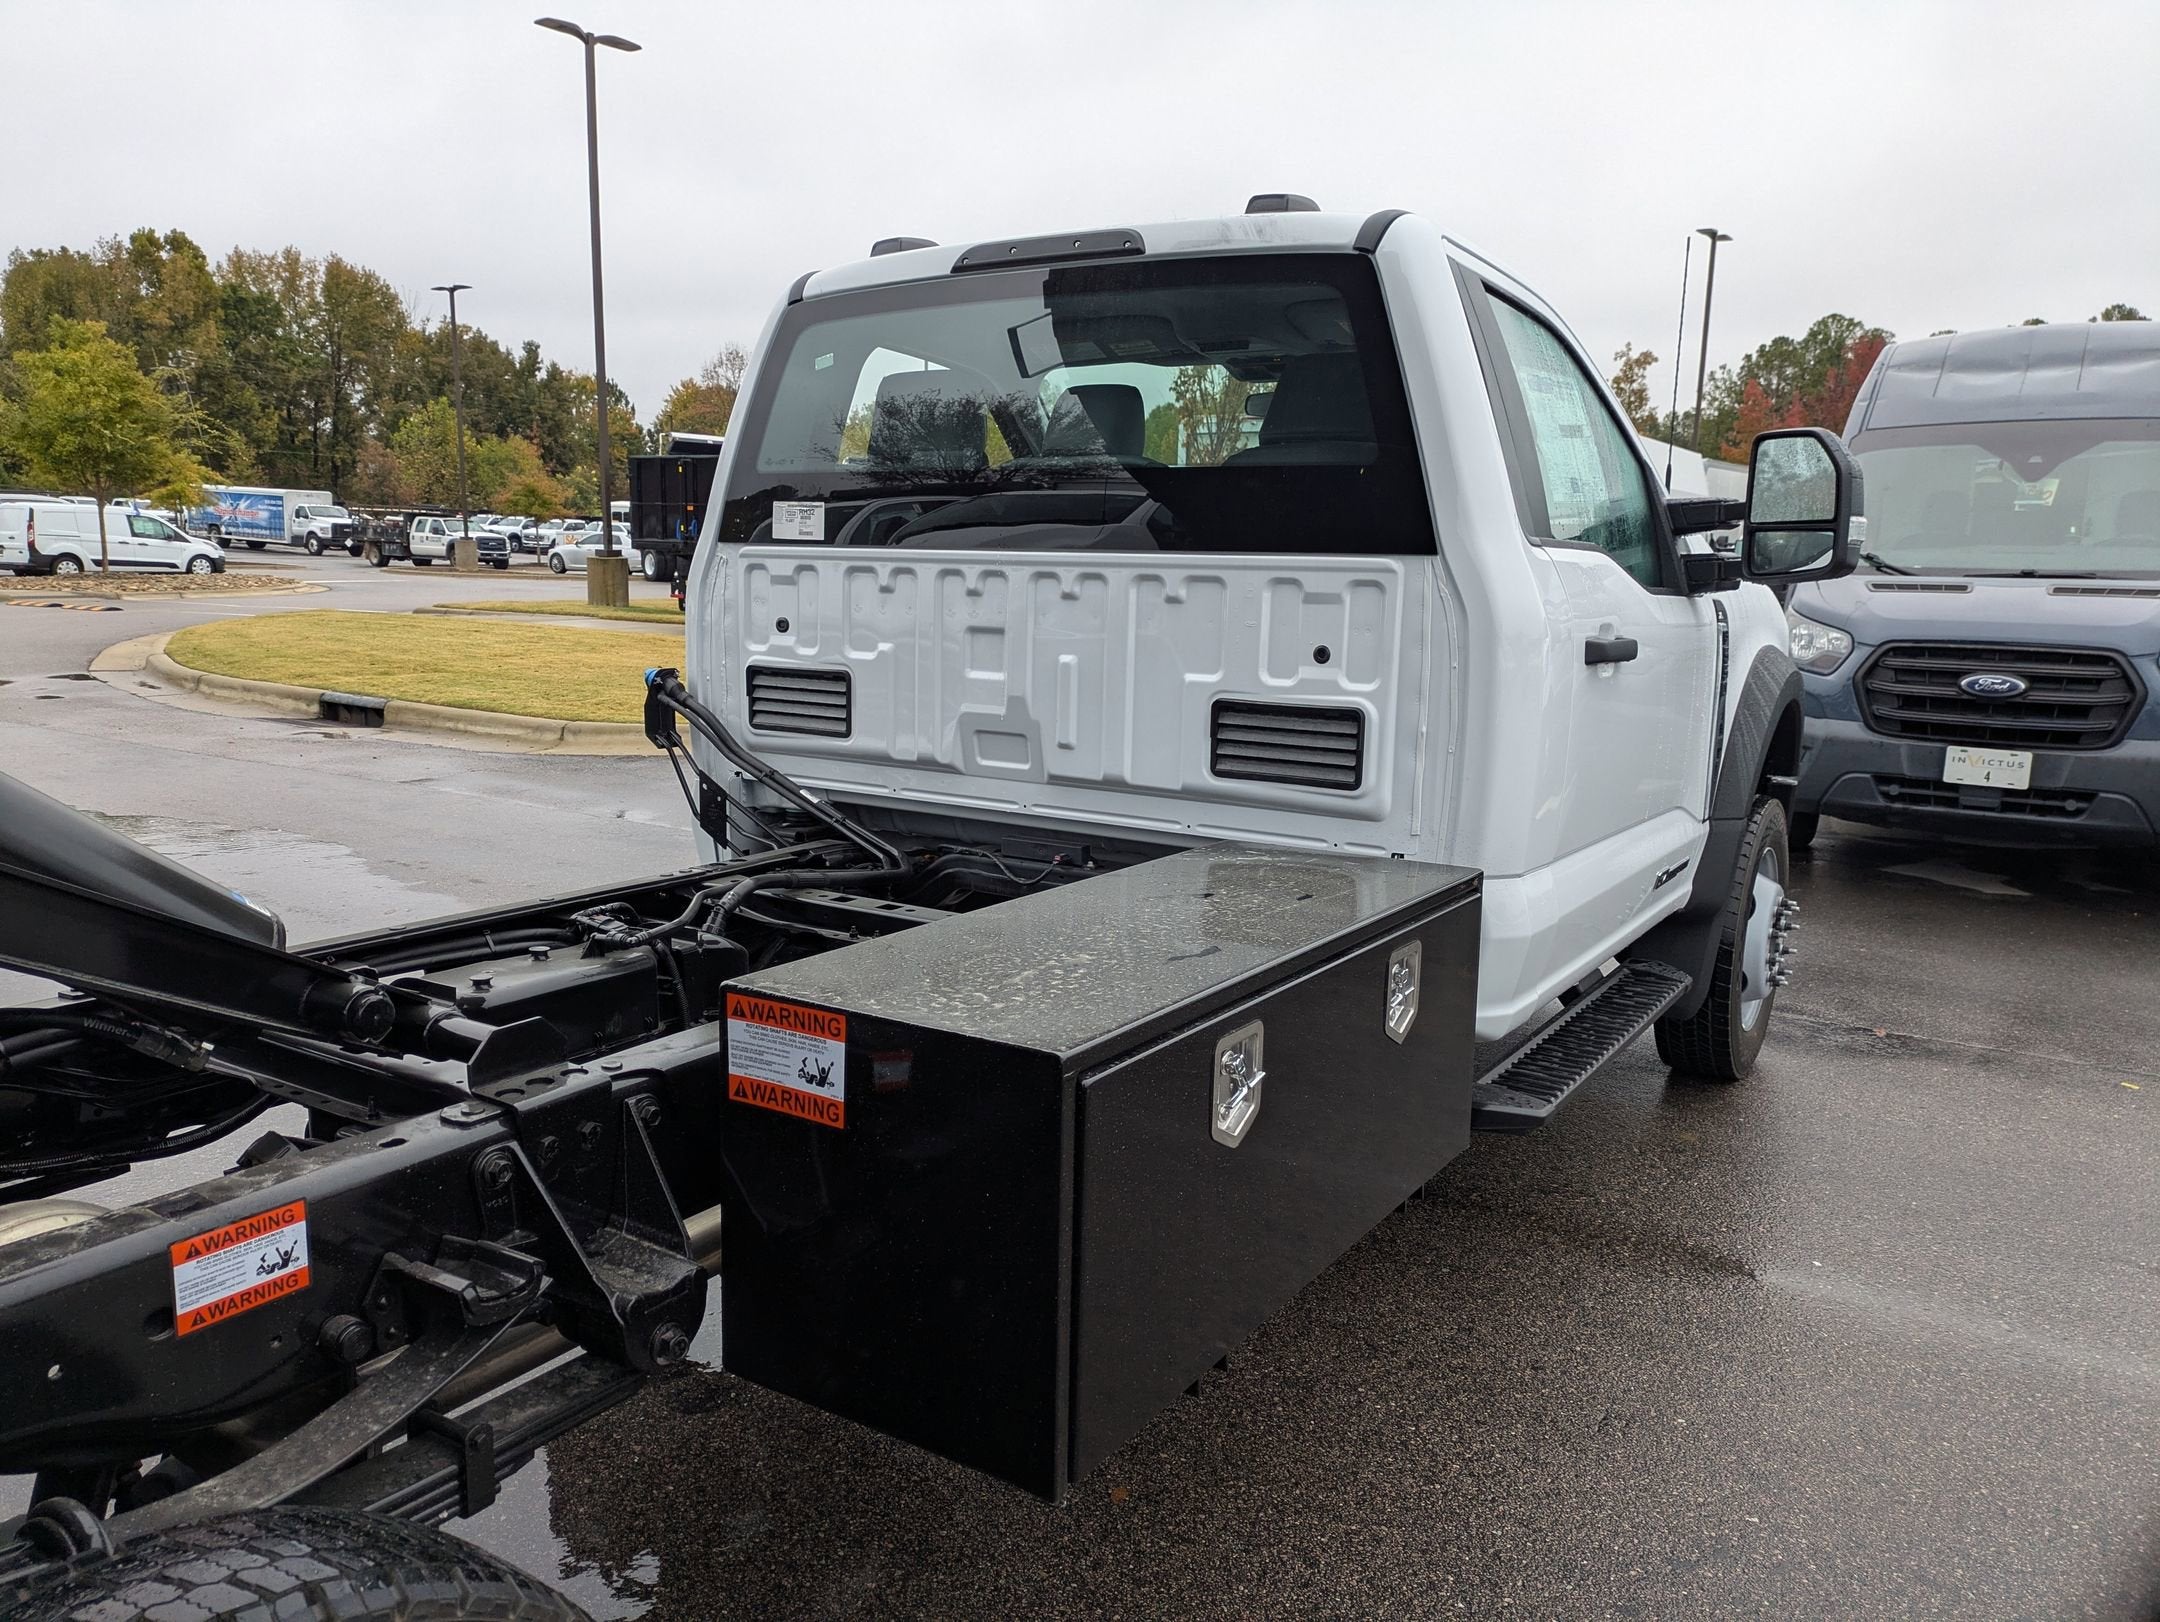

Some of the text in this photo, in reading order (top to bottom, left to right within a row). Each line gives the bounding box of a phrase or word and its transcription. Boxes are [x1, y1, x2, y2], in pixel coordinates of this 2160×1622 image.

[1975, 678, 2011, 691] Ford
[1952, 754, 2025, 769] INVICTUS
[1984, 771, 1991, 783] 4
[83, 1017, 128, 1036] Winner
[747, 1001, 841, 1038] WARNING
[798, 1034, 826, 1043] DANGEROUS
[750, 1081, 840, 1123] WARNING
[203, 1209, 295, 1252] WARNING
[208, 1274, 299, 1319] WARNING
